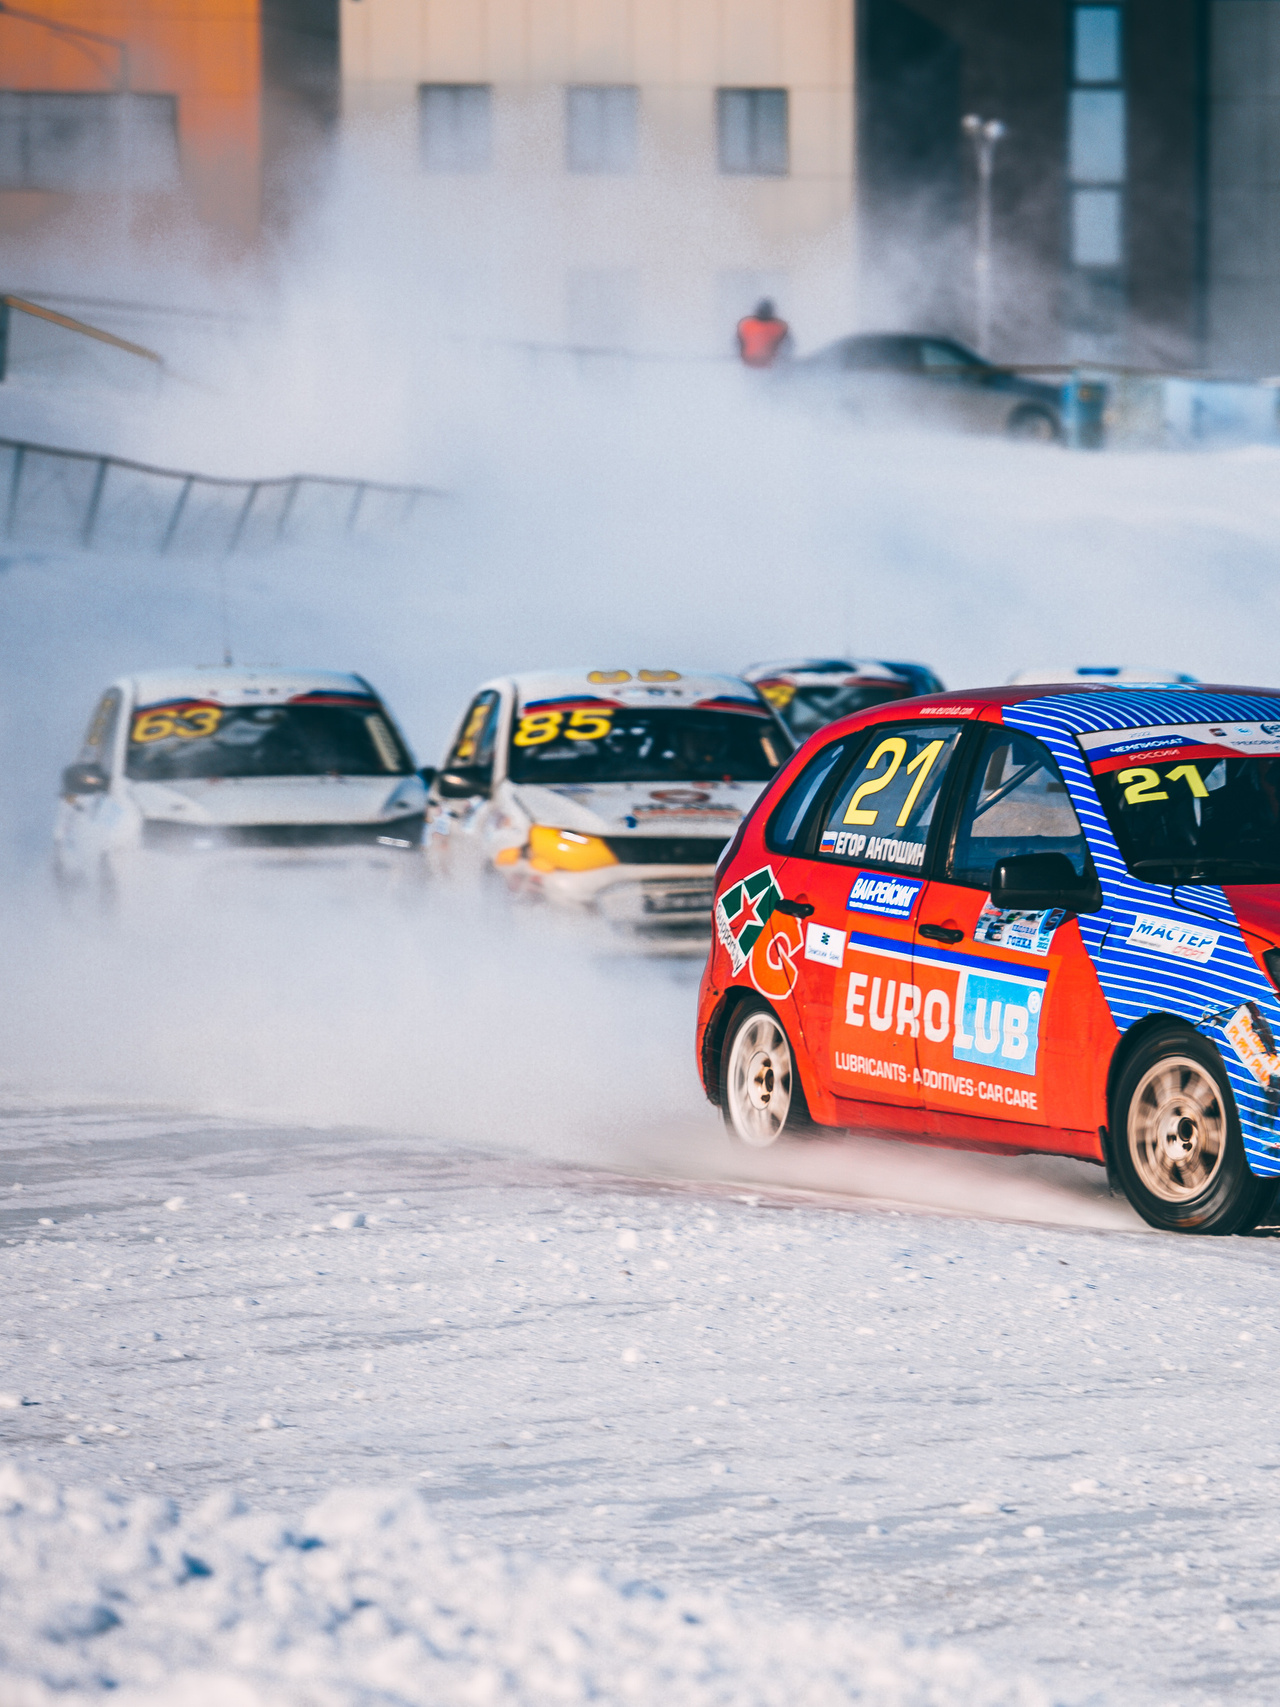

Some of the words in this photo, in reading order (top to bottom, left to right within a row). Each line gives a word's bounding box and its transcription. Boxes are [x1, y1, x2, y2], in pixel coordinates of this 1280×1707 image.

[131, 706, 223, 744] 63
[514, 708, 614, 747] 85
[1110, 737, 1184, 753] ЧЕМПИОНАТ
[1128, 748, 1181, 761] РОССИИ
[843, 737, 945, 827] 21
[1117, 765, 1210, 805] 21
[835, 831, 867, 858] ЕГОР
[865, 836, 927, 867] АНТОШИН
[850, 877, 920, 908] ВАЛ-РЕЙСИНГ
[1136, 918, 1214, 948] МАСТЕР
[845, 970, 1029, 1060] EUROLUB
